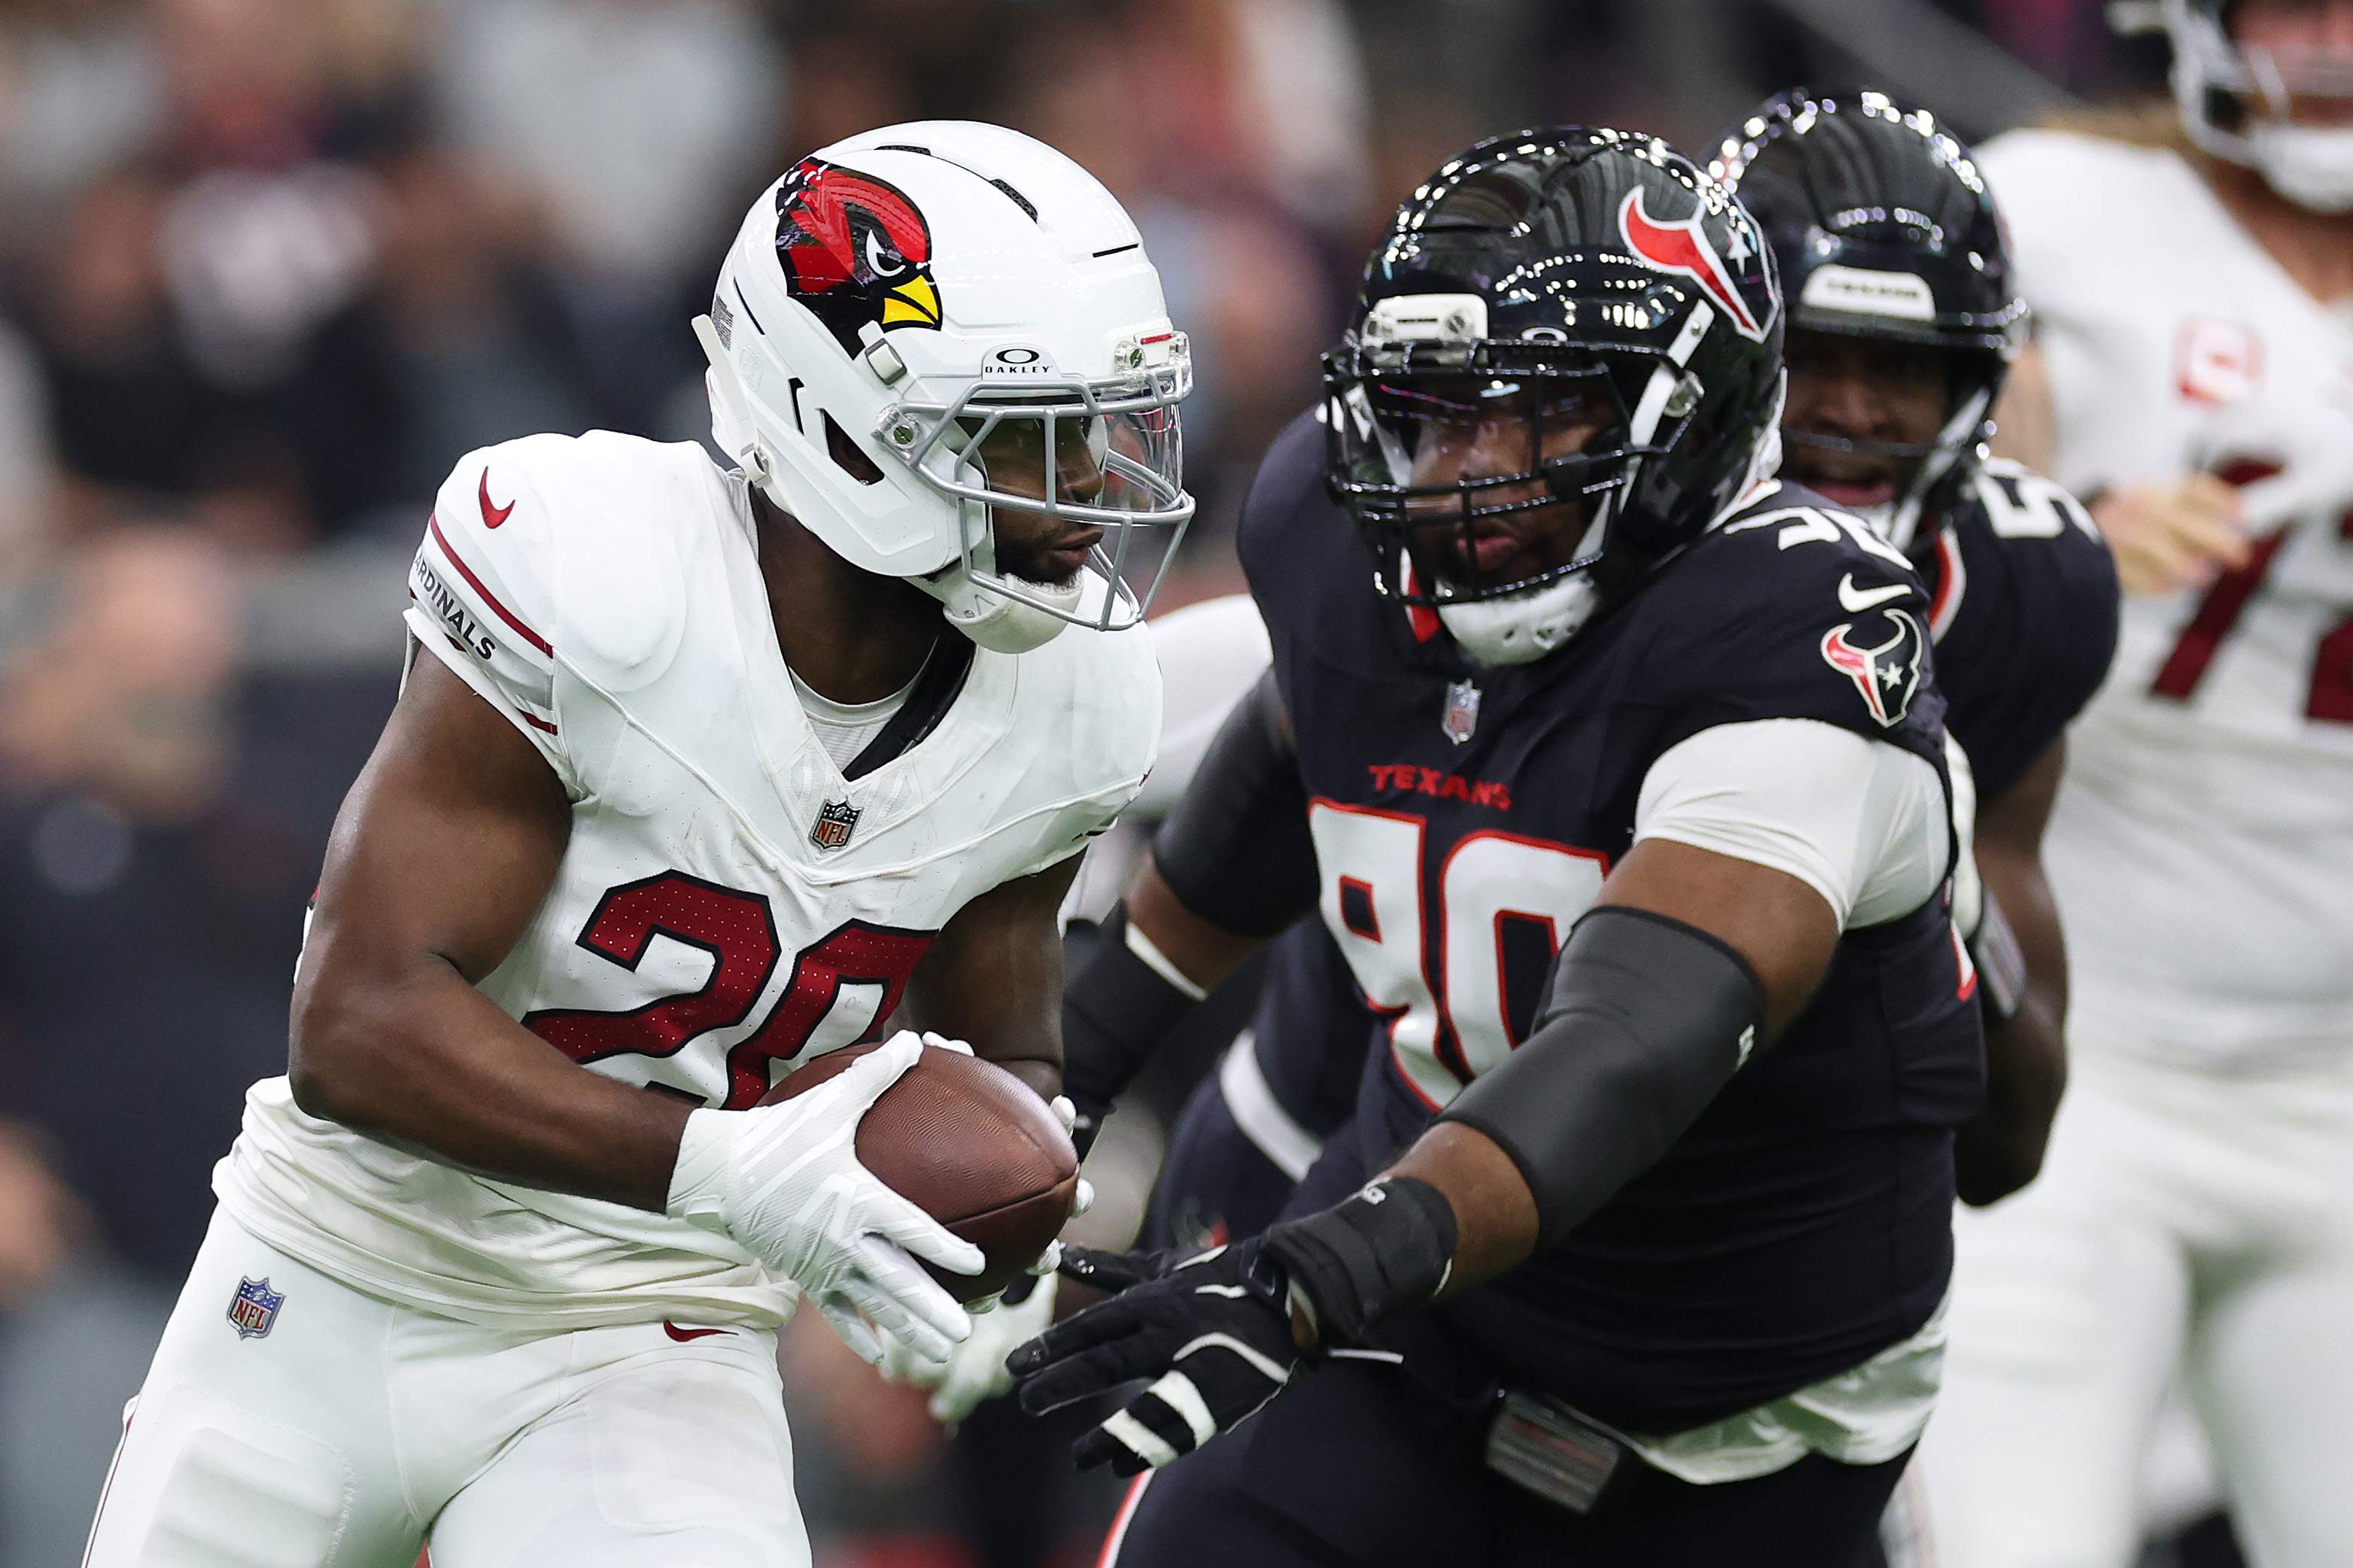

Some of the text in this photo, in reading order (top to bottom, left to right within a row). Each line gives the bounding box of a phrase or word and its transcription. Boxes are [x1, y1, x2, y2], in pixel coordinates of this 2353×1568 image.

[414, 553, 496, 660] ARDINALS
[1368, 763, 1512, 811] TEXANS
[1307, 795, 1613, 1115] 90
[233, 1299, 266, 1329] NFL
